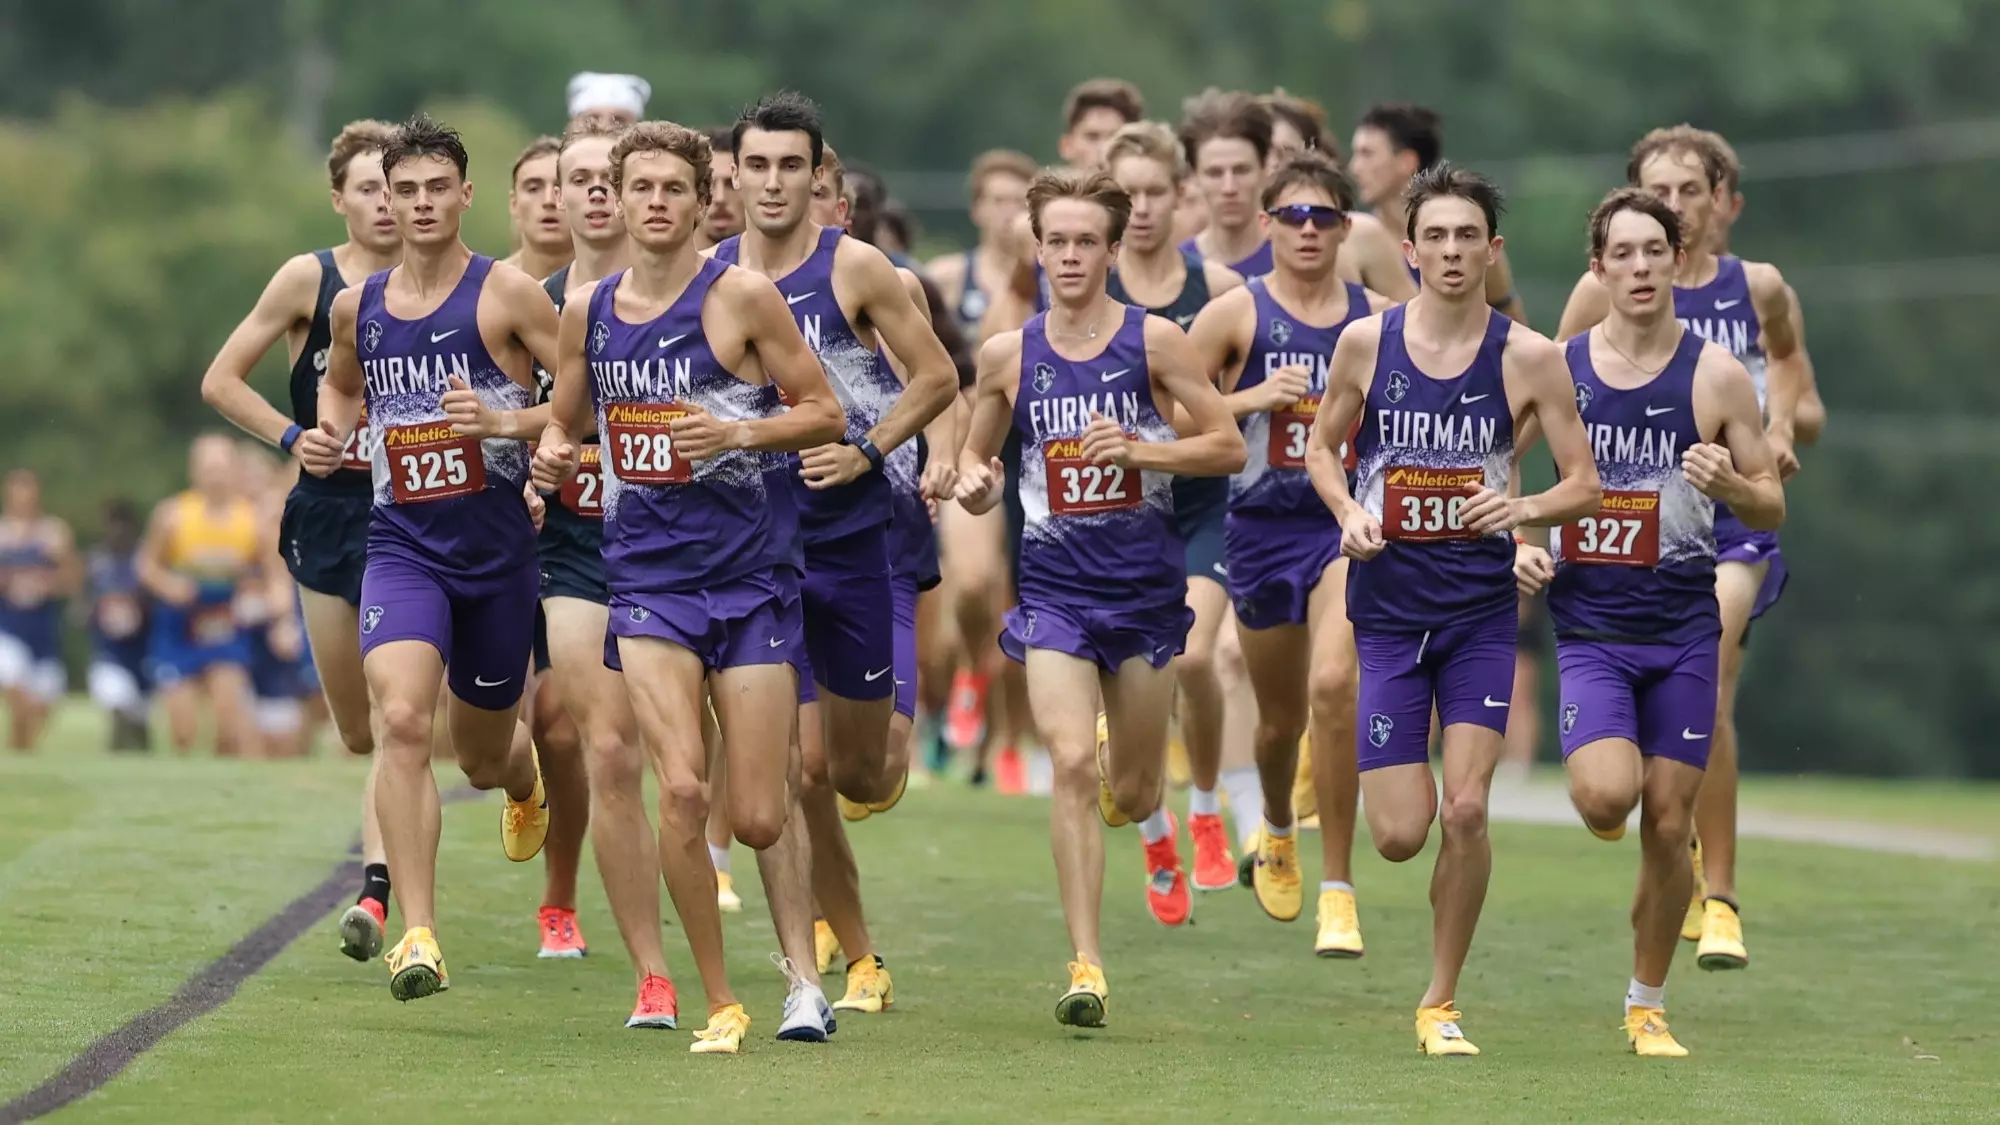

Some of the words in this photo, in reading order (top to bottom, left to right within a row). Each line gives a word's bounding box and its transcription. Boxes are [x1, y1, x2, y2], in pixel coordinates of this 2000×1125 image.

[1676, 318, 1747, 356] MAN
[364, 353, 471, 397] FURMAN
[1029, 391, 1138, 439] FURMAN
[1378, 409, 1496, 454] FURMAN
[620, 433, 672, 472] 328
[1587, 423, 1676, 469] RMAN
[401, 447, 467, 492] 325
[1061, 464, 1127, 504] 322
[1578, 517, 1643, 555] 327
